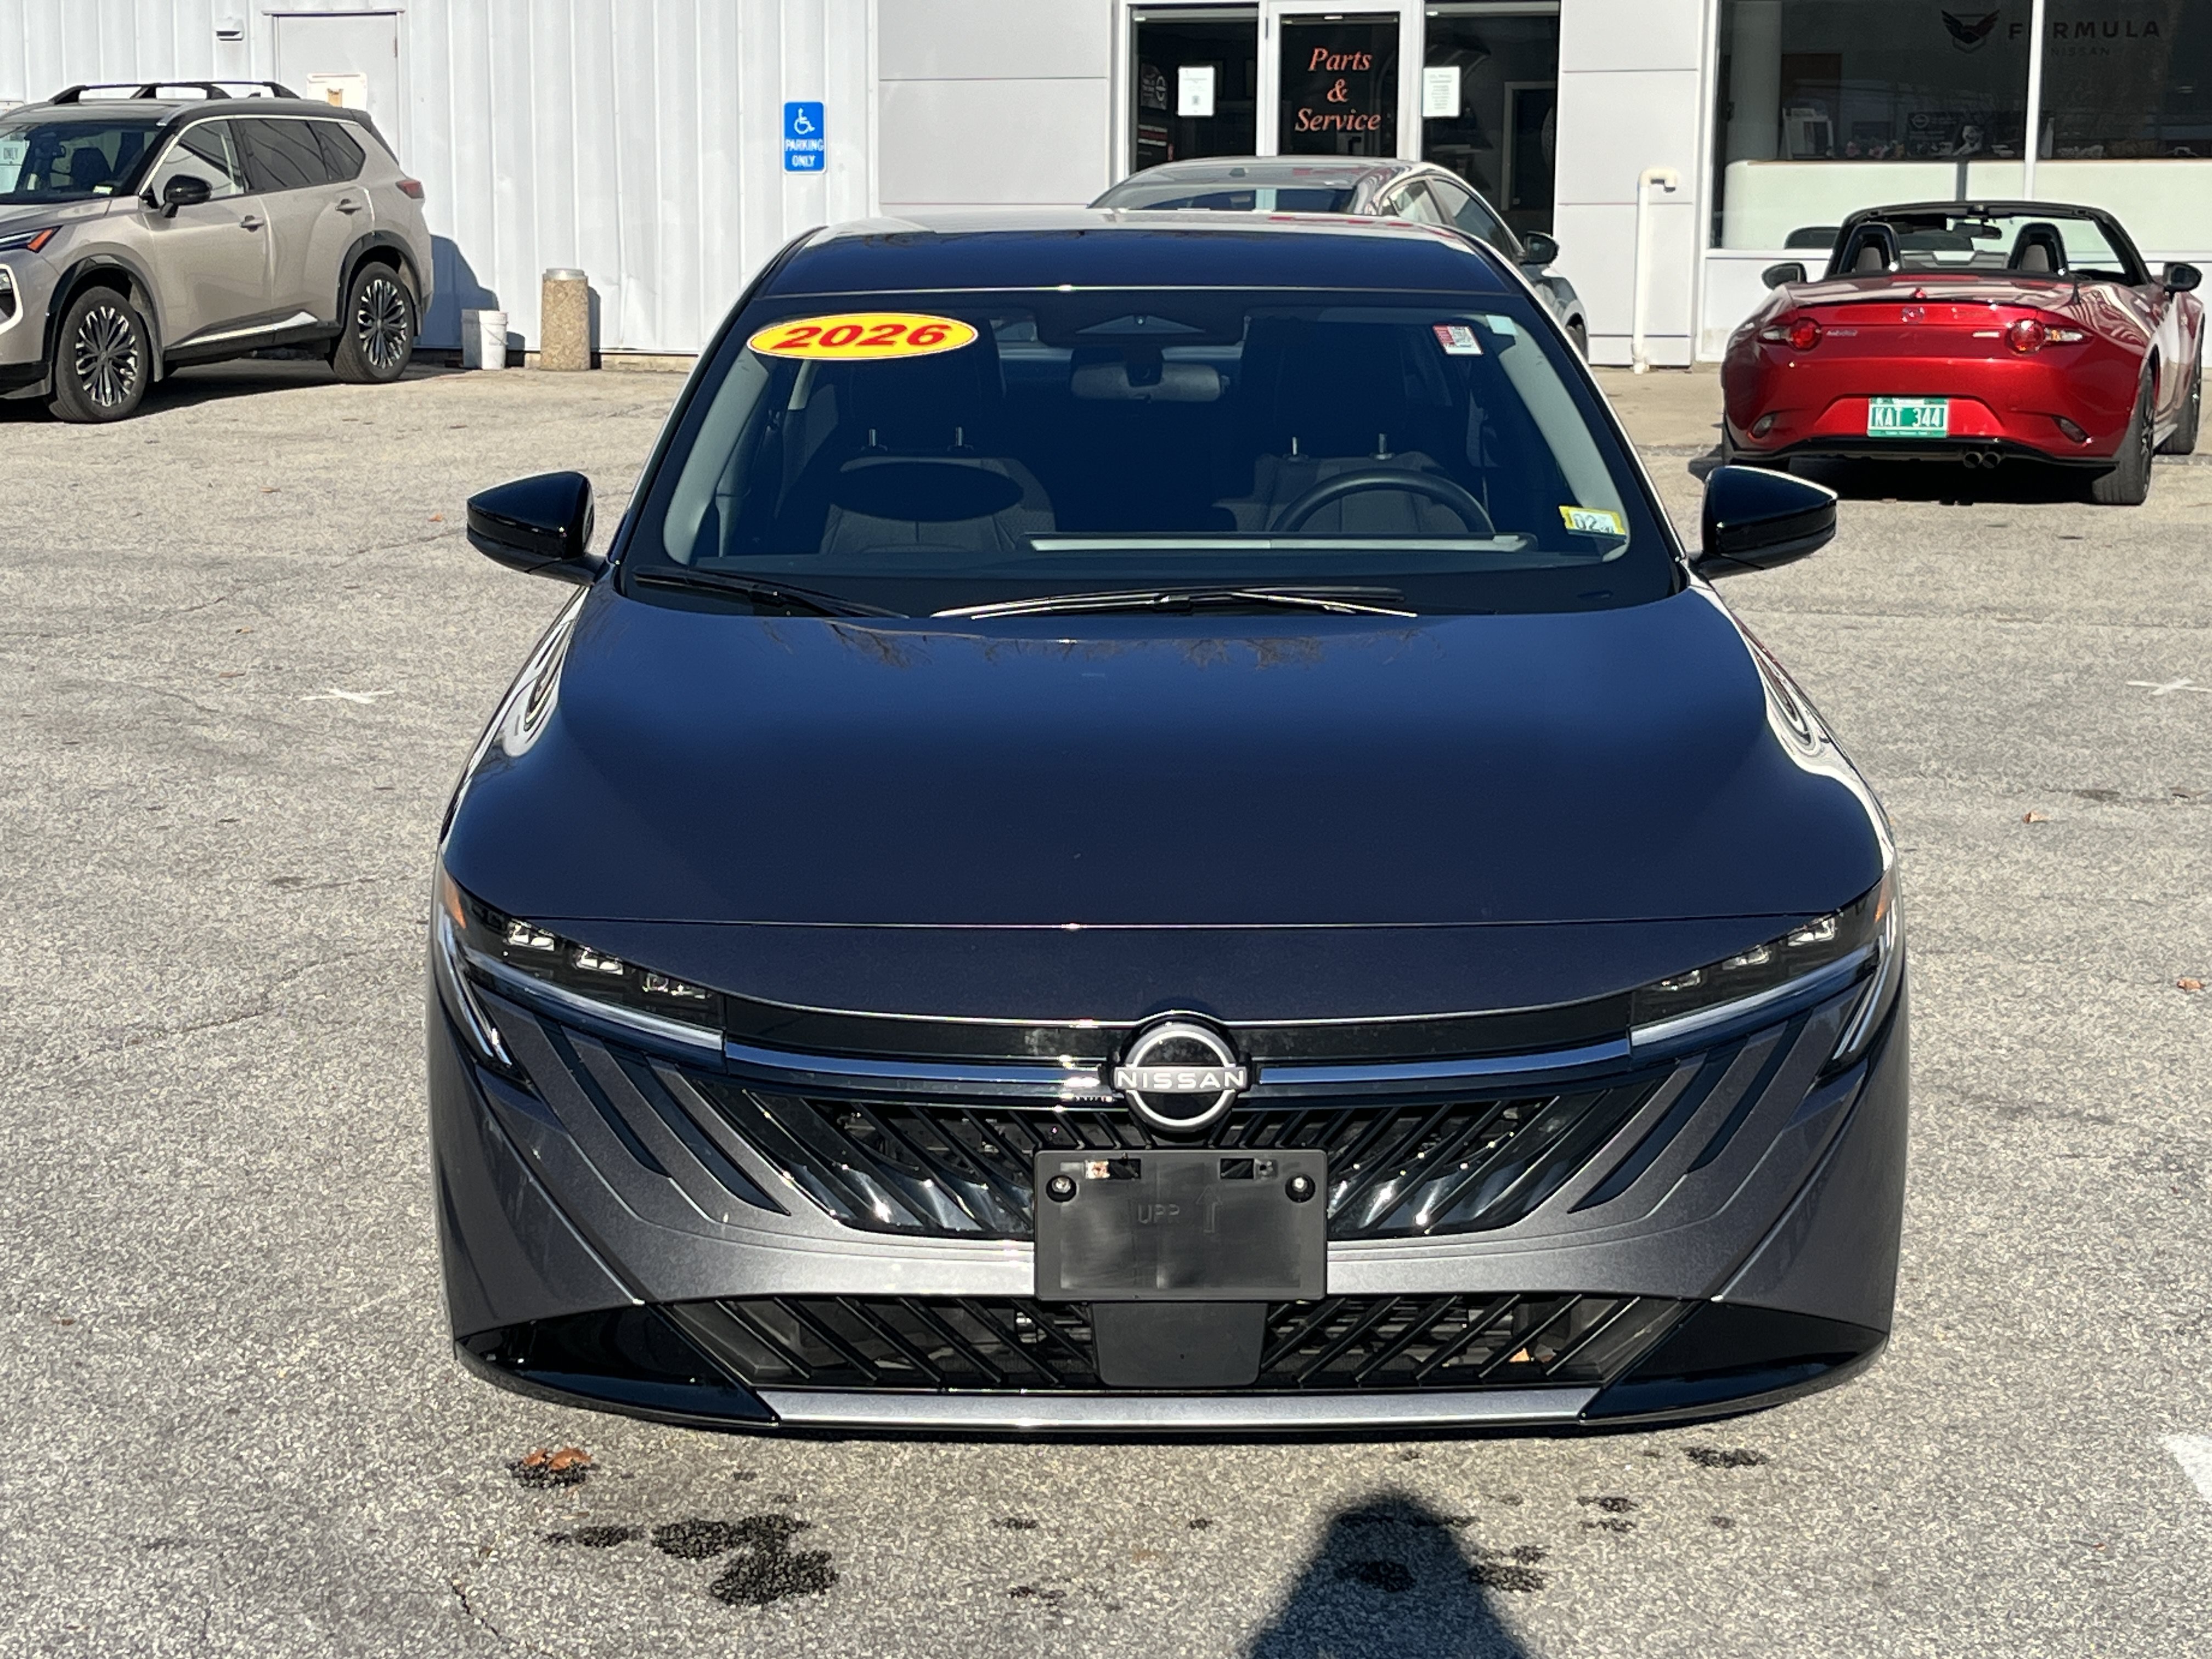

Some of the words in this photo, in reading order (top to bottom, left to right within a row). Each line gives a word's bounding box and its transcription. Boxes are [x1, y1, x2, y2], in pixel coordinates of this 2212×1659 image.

[2008, 21, 2159, 40] FRMULA
[1308, 47, 1372, 71] Parts
[1327, 78, 1350, 103] &
[1294, 108, 1381, 132] Service
[785, 139, 824, 151] PARKING
[792, 155, 816, 167] ONLY
[770, 324, 952, 350] 2026
[1875, 408, 1903, 427] KAT
[1912, 408, 1940, 427] 344
[1117, 1070, 1244, 1090] NISSAN
